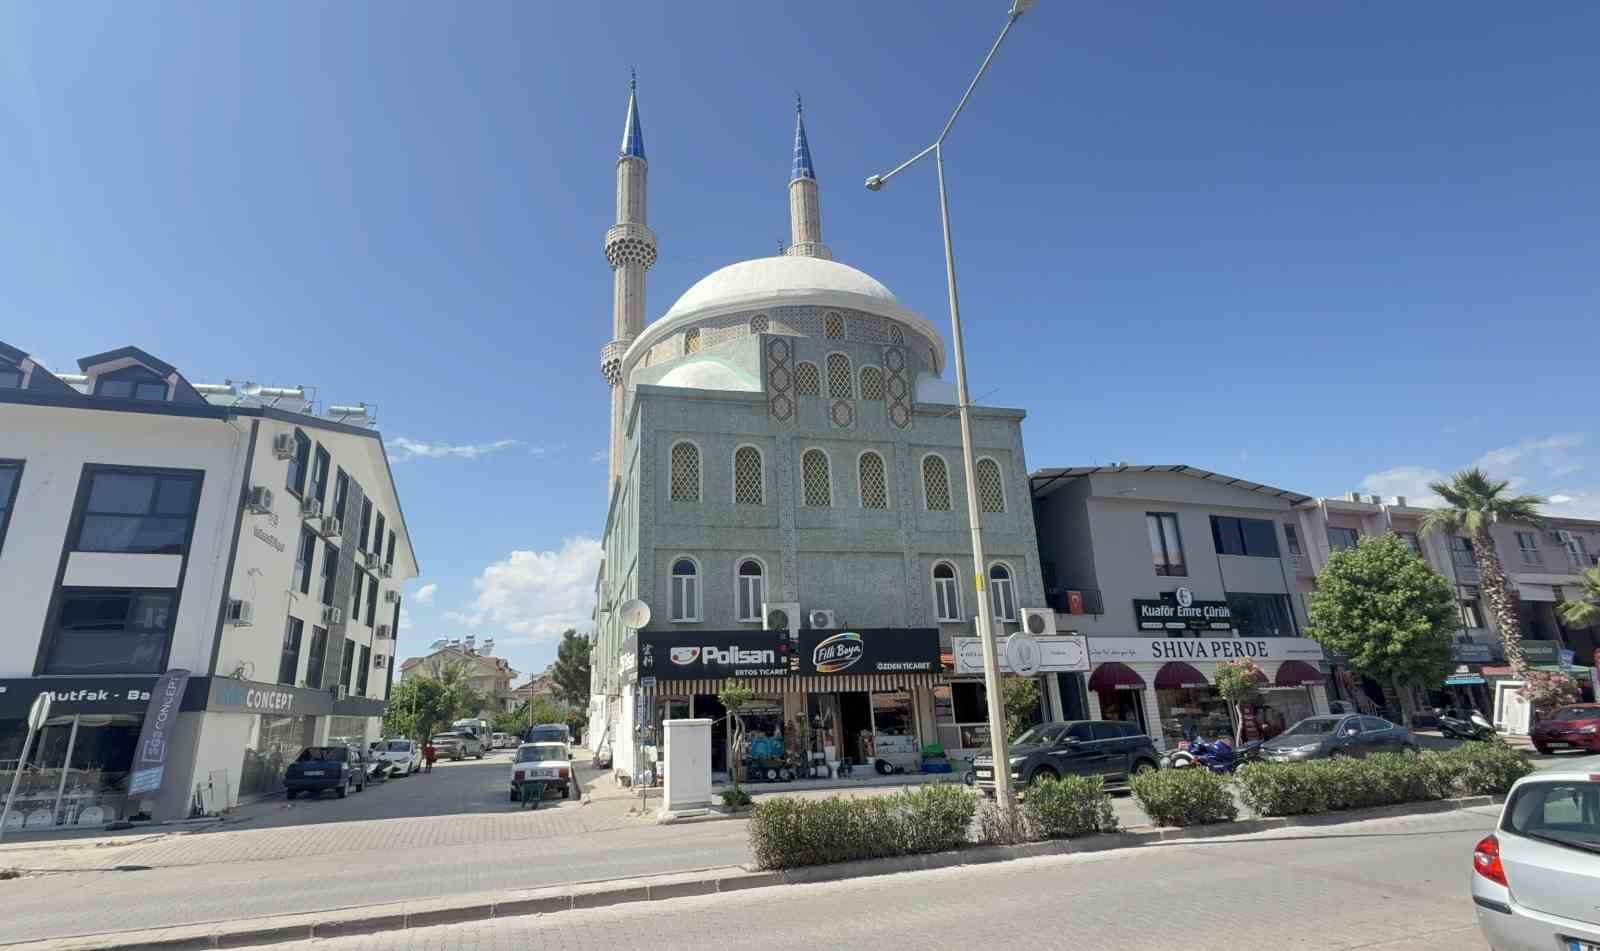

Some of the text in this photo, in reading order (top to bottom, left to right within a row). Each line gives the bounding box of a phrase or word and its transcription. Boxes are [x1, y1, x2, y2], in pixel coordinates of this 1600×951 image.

[1177, 606, 1202, 617] Emre
[702, 645, 775, 665] Polisan
[837, 644, 861, 658] Boya
[1151, 641, 1208, 658] SHIVA
[1211, 641, 1269, 658] PERDE
[127, 690, 151, 701] Ba
[246, 688, 294, 710] CONCEPT
